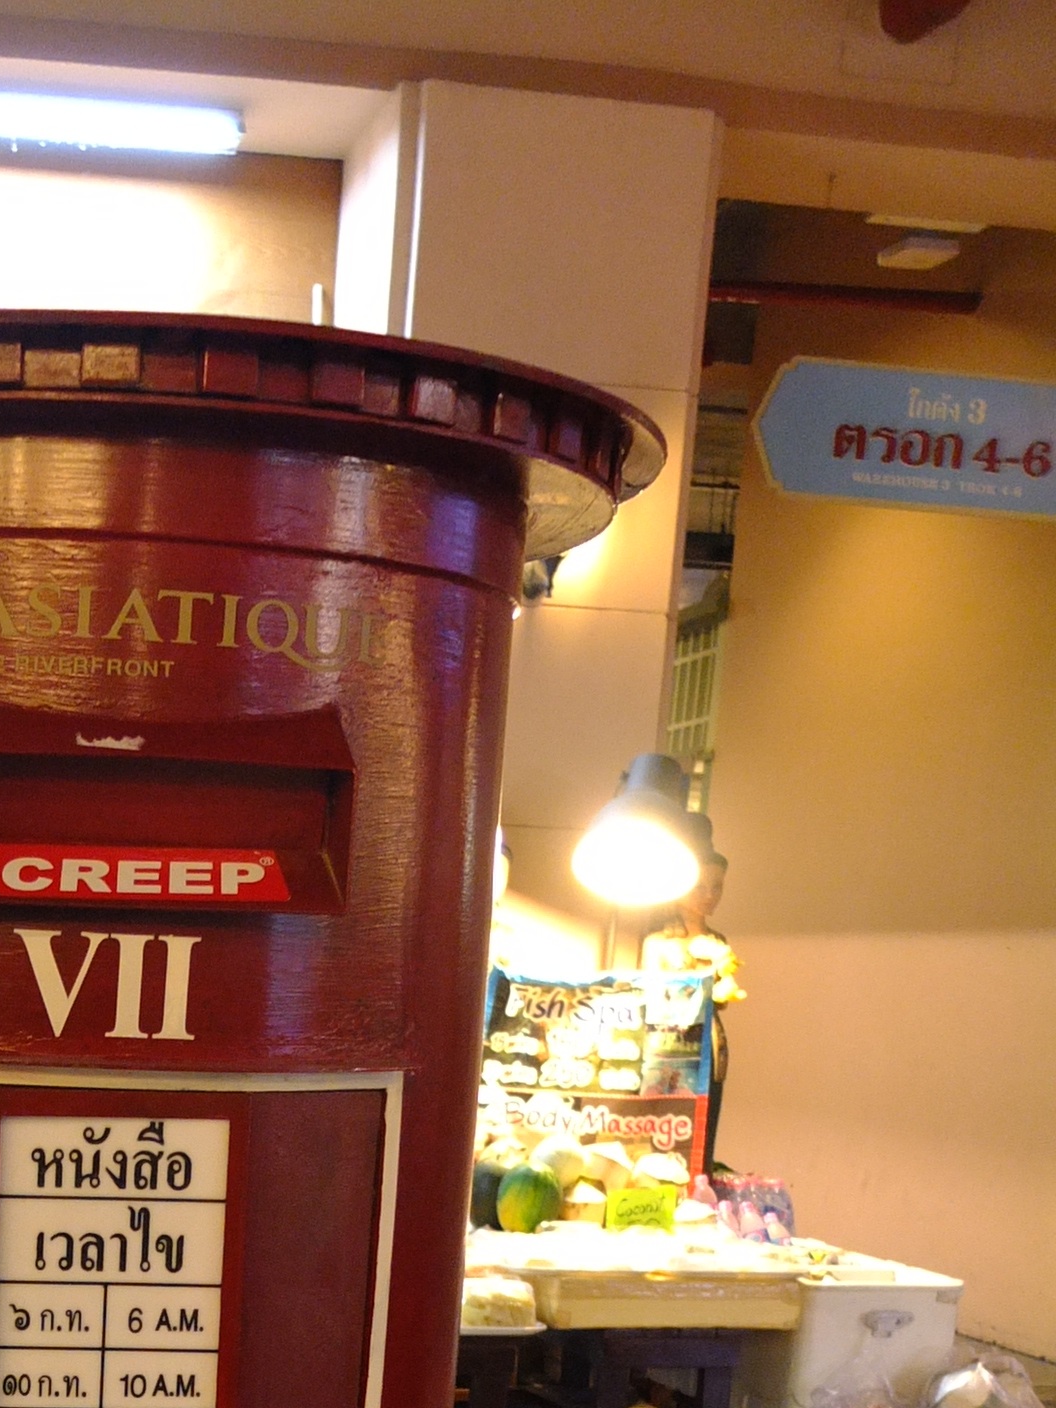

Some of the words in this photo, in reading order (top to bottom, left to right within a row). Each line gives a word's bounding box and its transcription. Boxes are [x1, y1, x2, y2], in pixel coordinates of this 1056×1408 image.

[967, 398, 989, 425] 3
[831, 423, 964, 470] ตรอก
[972, 437, 1052, 479] 4-6
[12, 655, 176, 679] RIVERFRONT
[12, 927, 203, 1041] VII
[503, 1100, 574, 1136] Body
[581, 1108, 692, 1147] Massage
[31, 1121, 193, 1192] หนังสือ
[34, 1205, 185, 1273] เวลาไข
[127, 1308, 143, 1333] 6
[155, 1308, 204, 1332] A.M.
[119, 1374, 147, 1398] 10
[152, 1374, 201, 1398] A.M.
